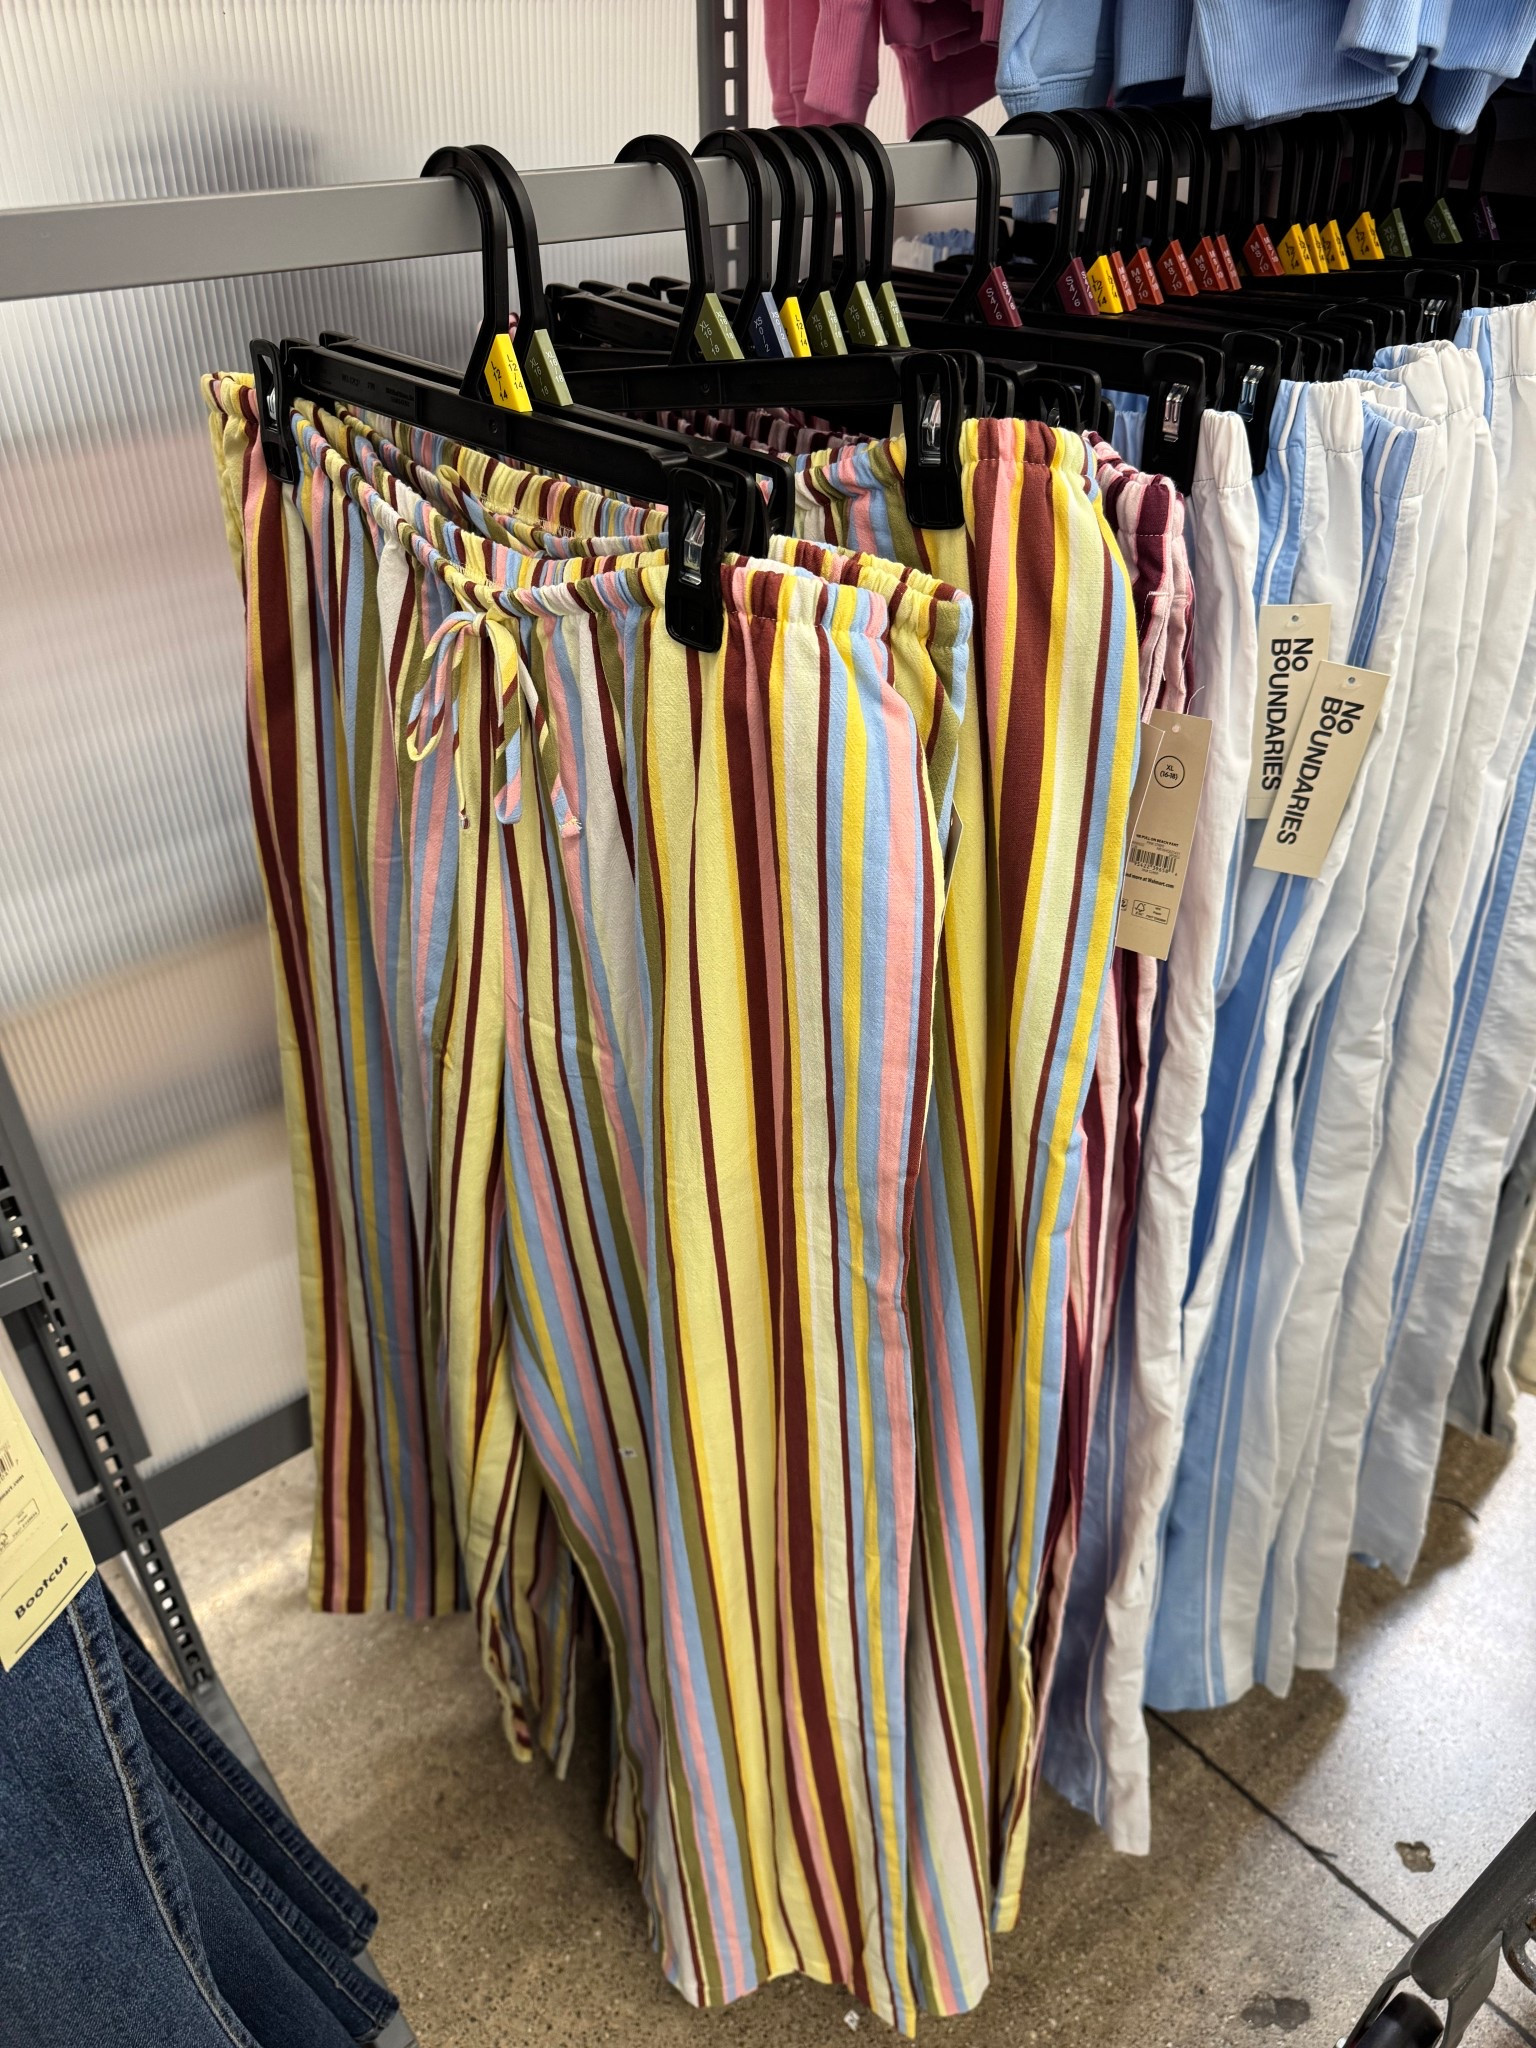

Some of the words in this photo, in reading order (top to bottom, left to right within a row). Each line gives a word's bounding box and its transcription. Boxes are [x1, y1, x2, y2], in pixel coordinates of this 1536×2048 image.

[1291, 637, 1314, 672] NO
[1261, 638, 1292, 791] BOUNDARIES
[1336, 700, 1365, 735] NO
[1276, 695, 1343, 845] BOUNDARIES
[1147, 878, 1175, 889] Walmart.com
[14, 1556, 69, 1620] Bootcut
